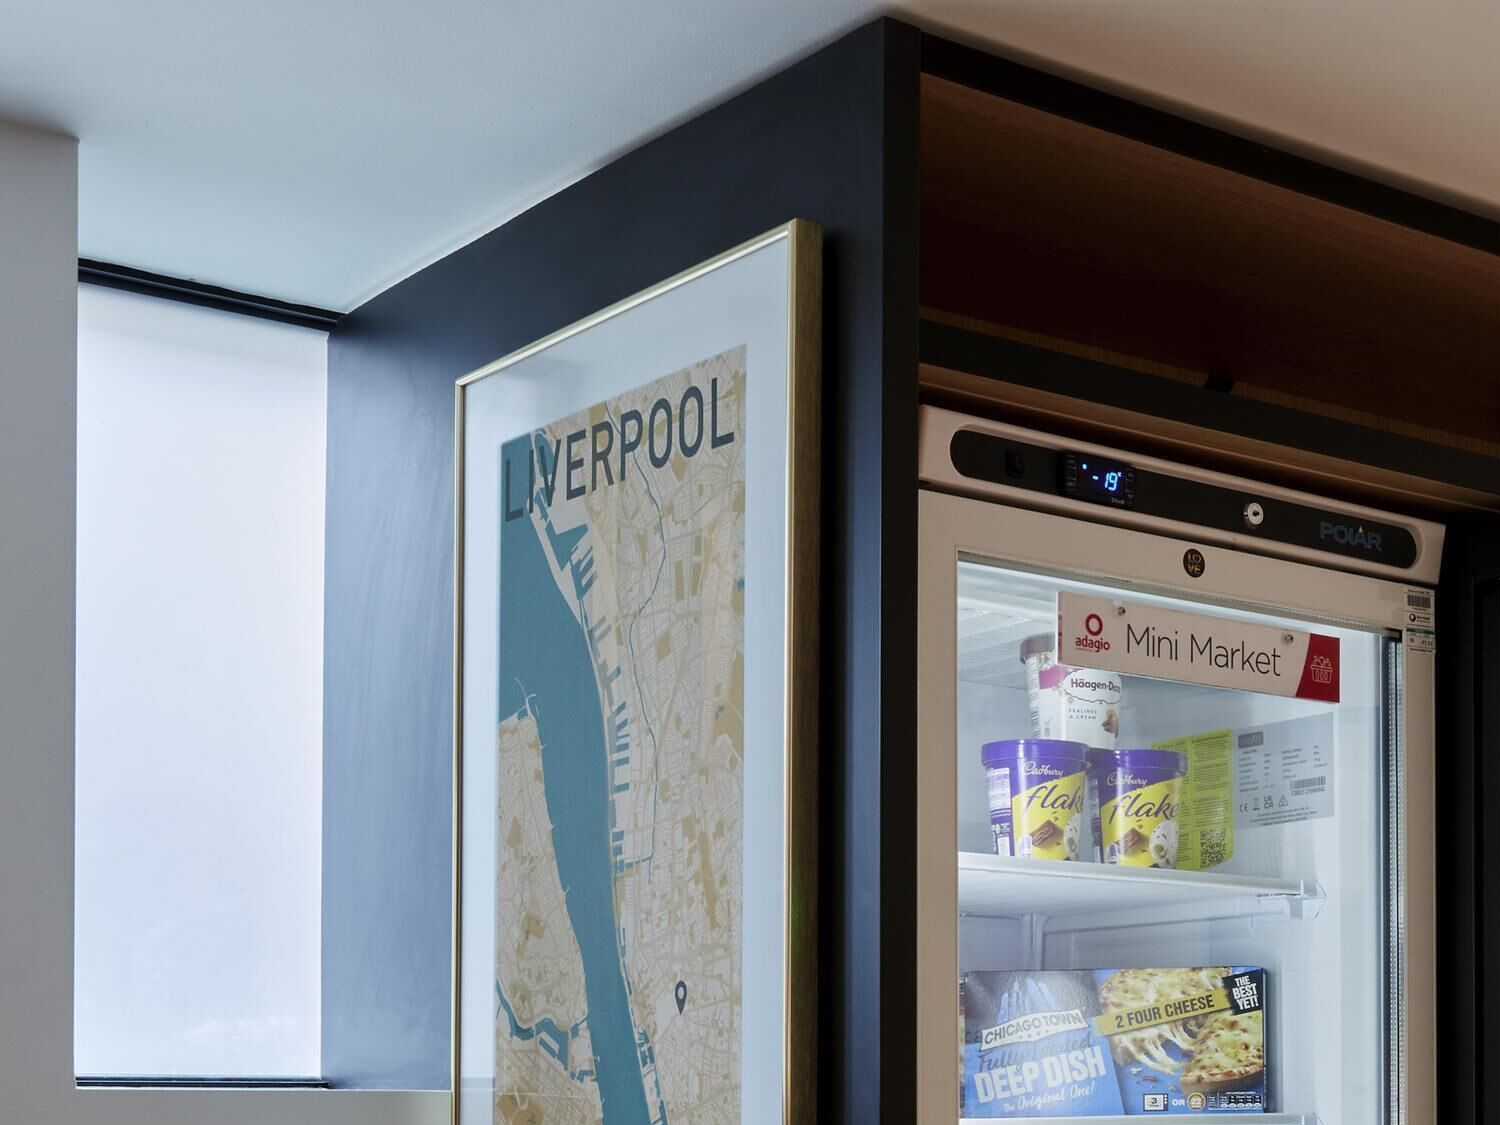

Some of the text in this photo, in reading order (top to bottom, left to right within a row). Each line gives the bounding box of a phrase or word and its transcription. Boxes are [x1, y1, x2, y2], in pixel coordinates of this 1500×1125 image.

[505, 377, 734, 522] LIVERPOOL
[1075, 635, 1111, 653] adagio
[1126, 623, 1282, 677] Mini Market
[1023, 760, 1064, 778] Cadbury
[1232, 983, 1257, 999] BEST
[1234, 975, 1251, 987] THE
[1115, 994, 1215, 1028] 2 FOUR CHEESE
[1236, 996, 1259, 1011] YET!
[984, 1012, 1084, 1045] CHICAGO TOWN
[974, 1045, 1107, 1104] DEEP DISH
